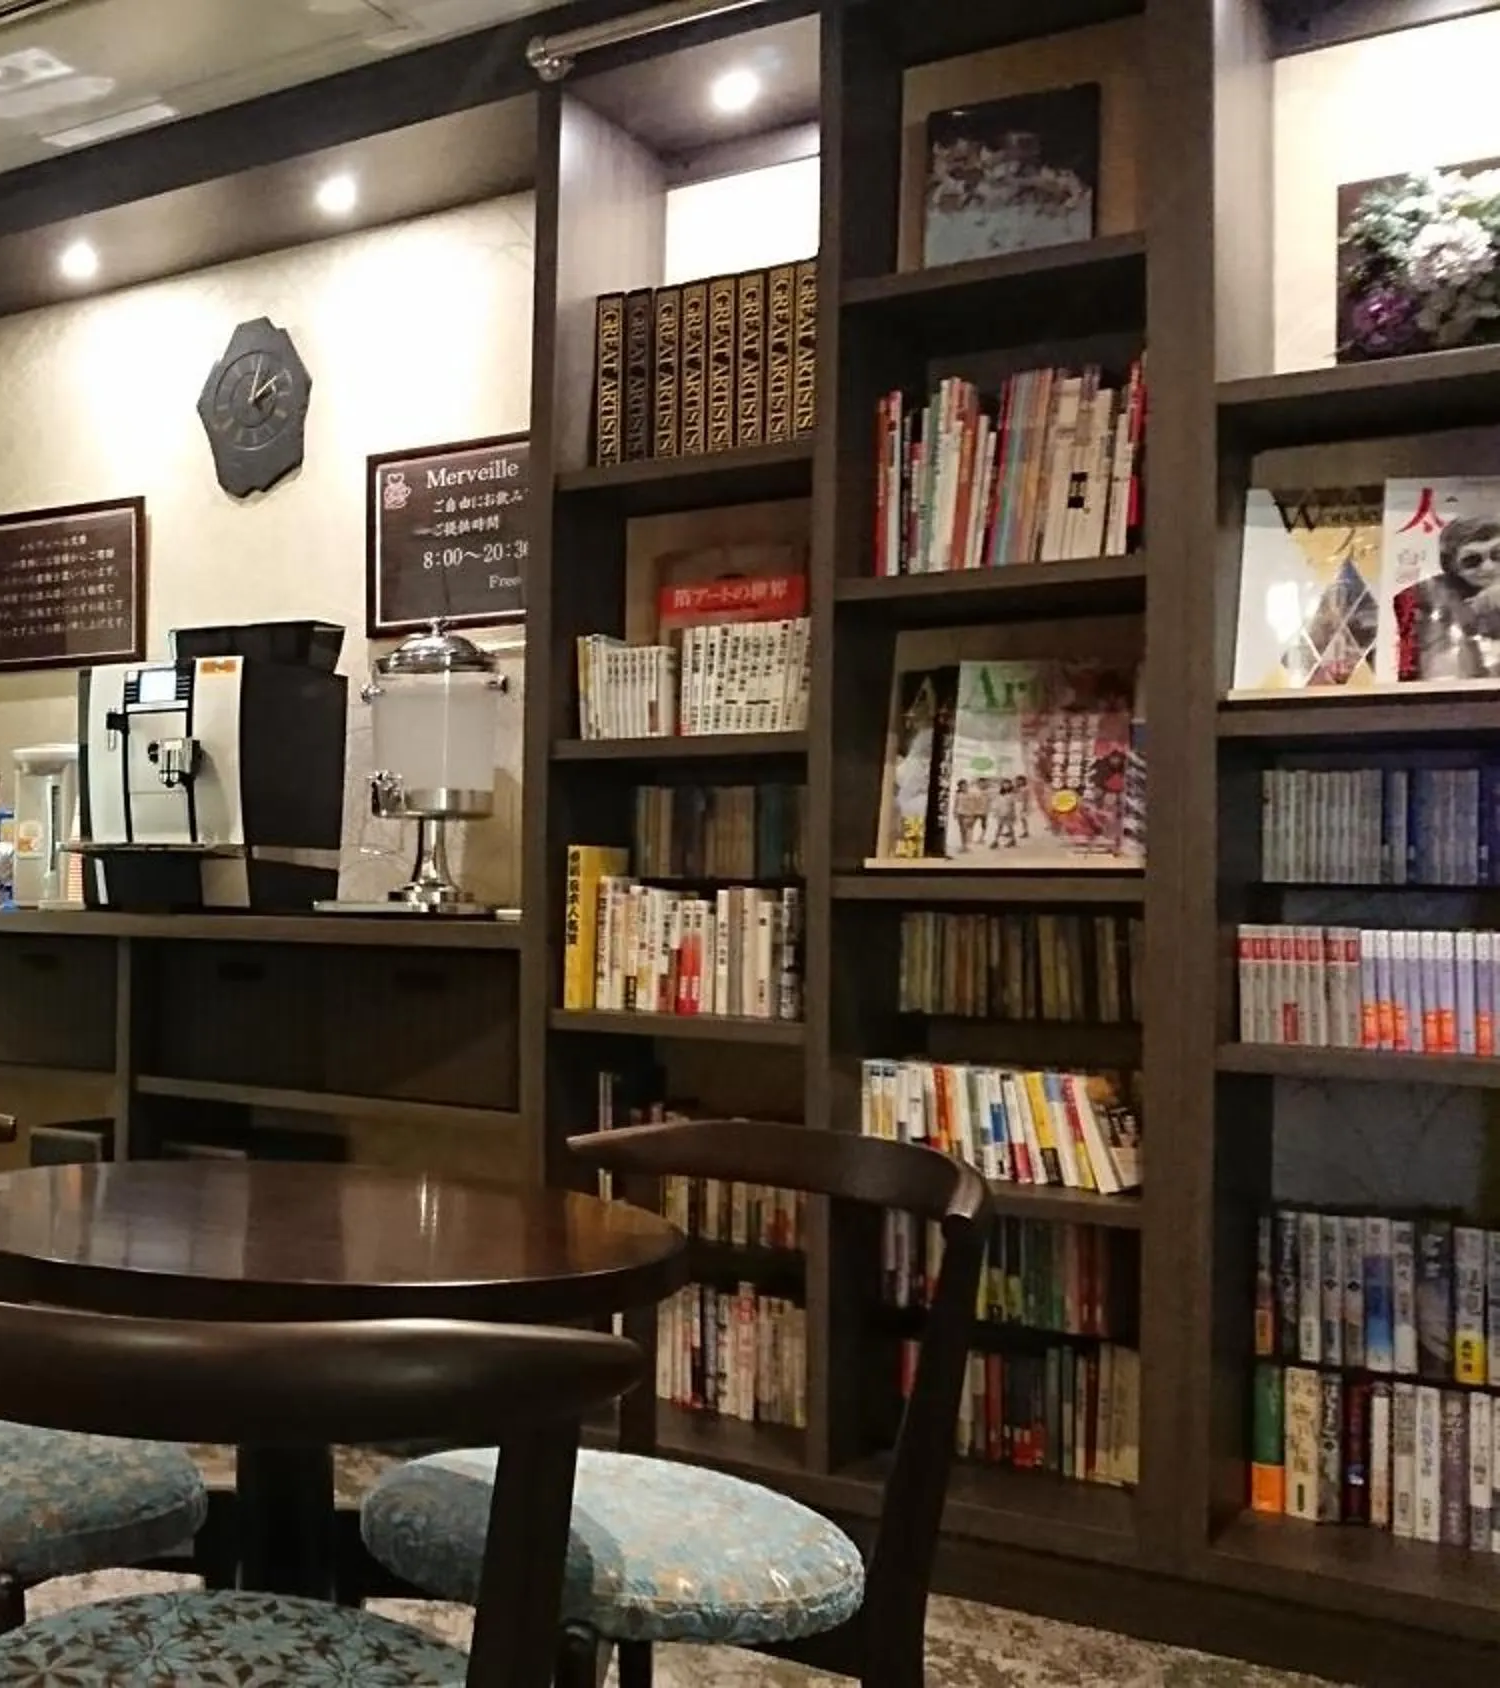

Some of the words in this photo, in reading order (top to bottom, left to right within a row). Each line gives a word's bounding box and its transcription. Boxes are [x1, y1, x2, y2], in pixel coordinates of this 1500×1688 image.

[602, 310, 620, 374] GREAT
[658, 303, 675, 368] GREAT
[684, 298, 701, 364] GREAT
[712, 291, 730, 359] GREAT
[741, 287, 759, 355] GREAT
[770, 279, 790, 347] GREAT
[798, 275, 816, 342] GREAT
[602, 378, 620, 457] ARTISTS
[658, 372, 675, 451] ARTISTS
[684, 368, 701, 448] ARTISTS
[712, 363, 730, 444] ARTISTS
[741, 359, 759, 441] ARTISTS
[770, 352, 790, 435] ARTISTS
[798, 346, 816, 431] ARTISTS
[426, 458, 520, 489] Merveille
[433, 488, 529, 513] ご自由にお飲み
